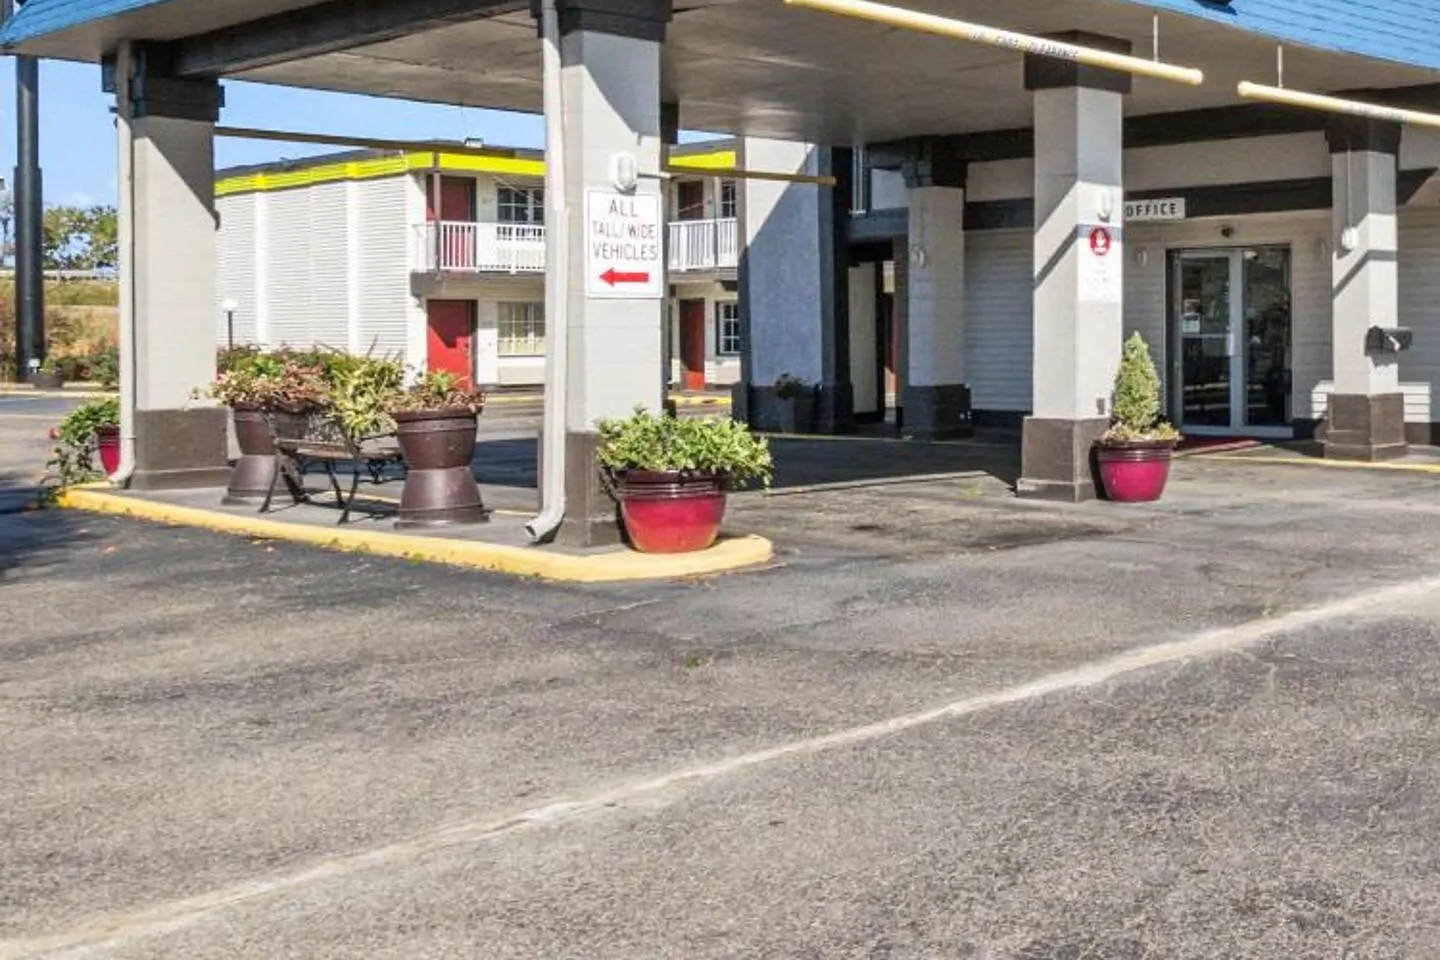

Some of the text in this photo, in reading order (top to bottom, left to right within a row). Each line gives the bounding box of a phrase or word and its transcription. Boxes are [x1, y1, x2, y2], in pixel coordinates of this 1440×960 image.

[609, 198, 639, 218] ALL
[1124, 202, 1177, 217] OFFICE
[593, 241, 658, 261] VEHICLES
